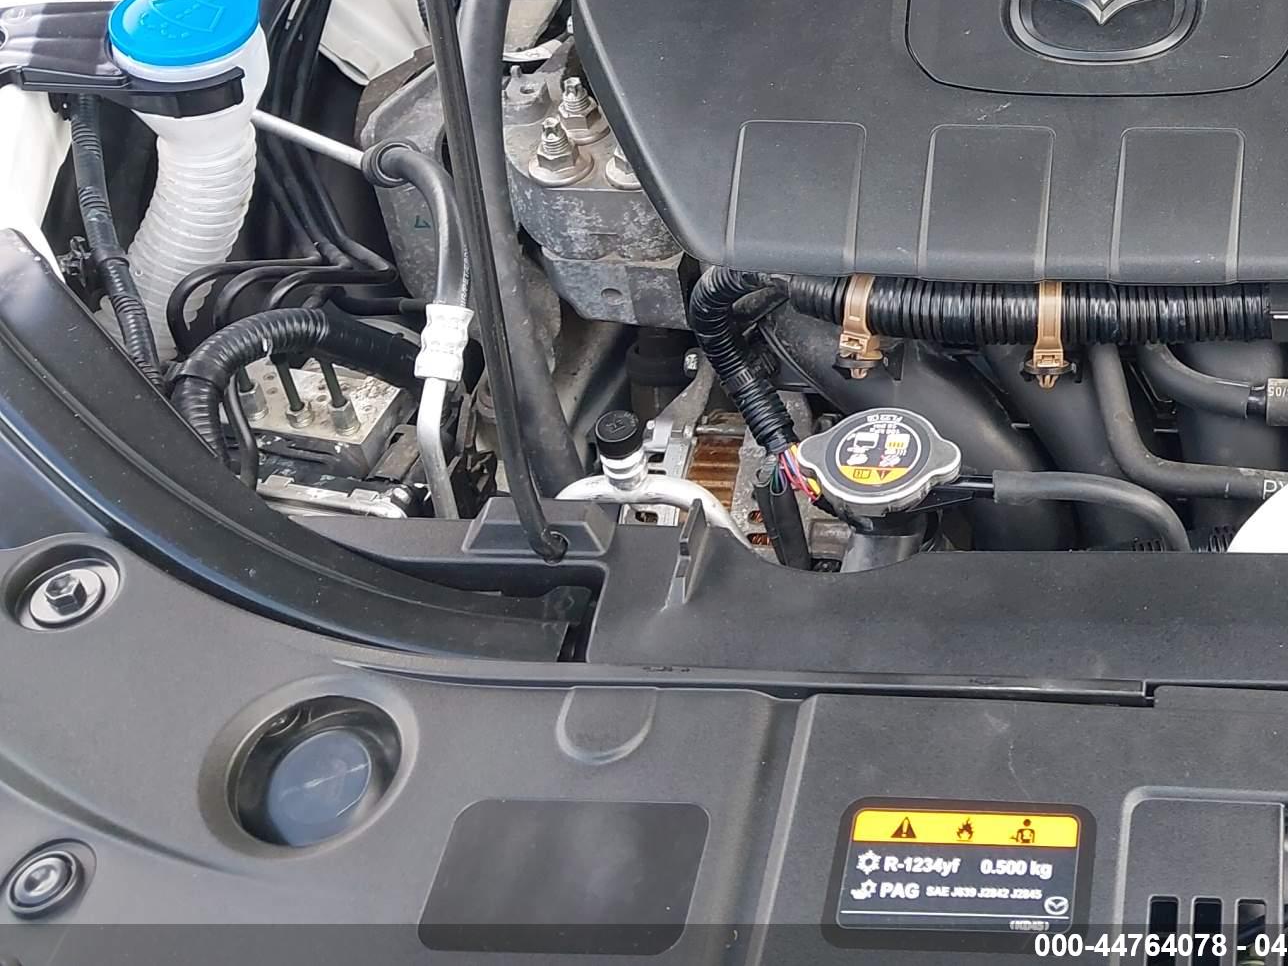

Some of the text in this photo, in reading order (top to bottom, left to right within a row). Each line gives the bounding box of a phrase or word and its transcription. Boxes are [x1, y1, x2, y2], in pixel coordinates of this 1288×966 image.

[883, 855, 1053, 880] R-1234yf 0.500 kg
[880, 881, 920, 899] PAG
[926, 885, 951, 897] SAE
